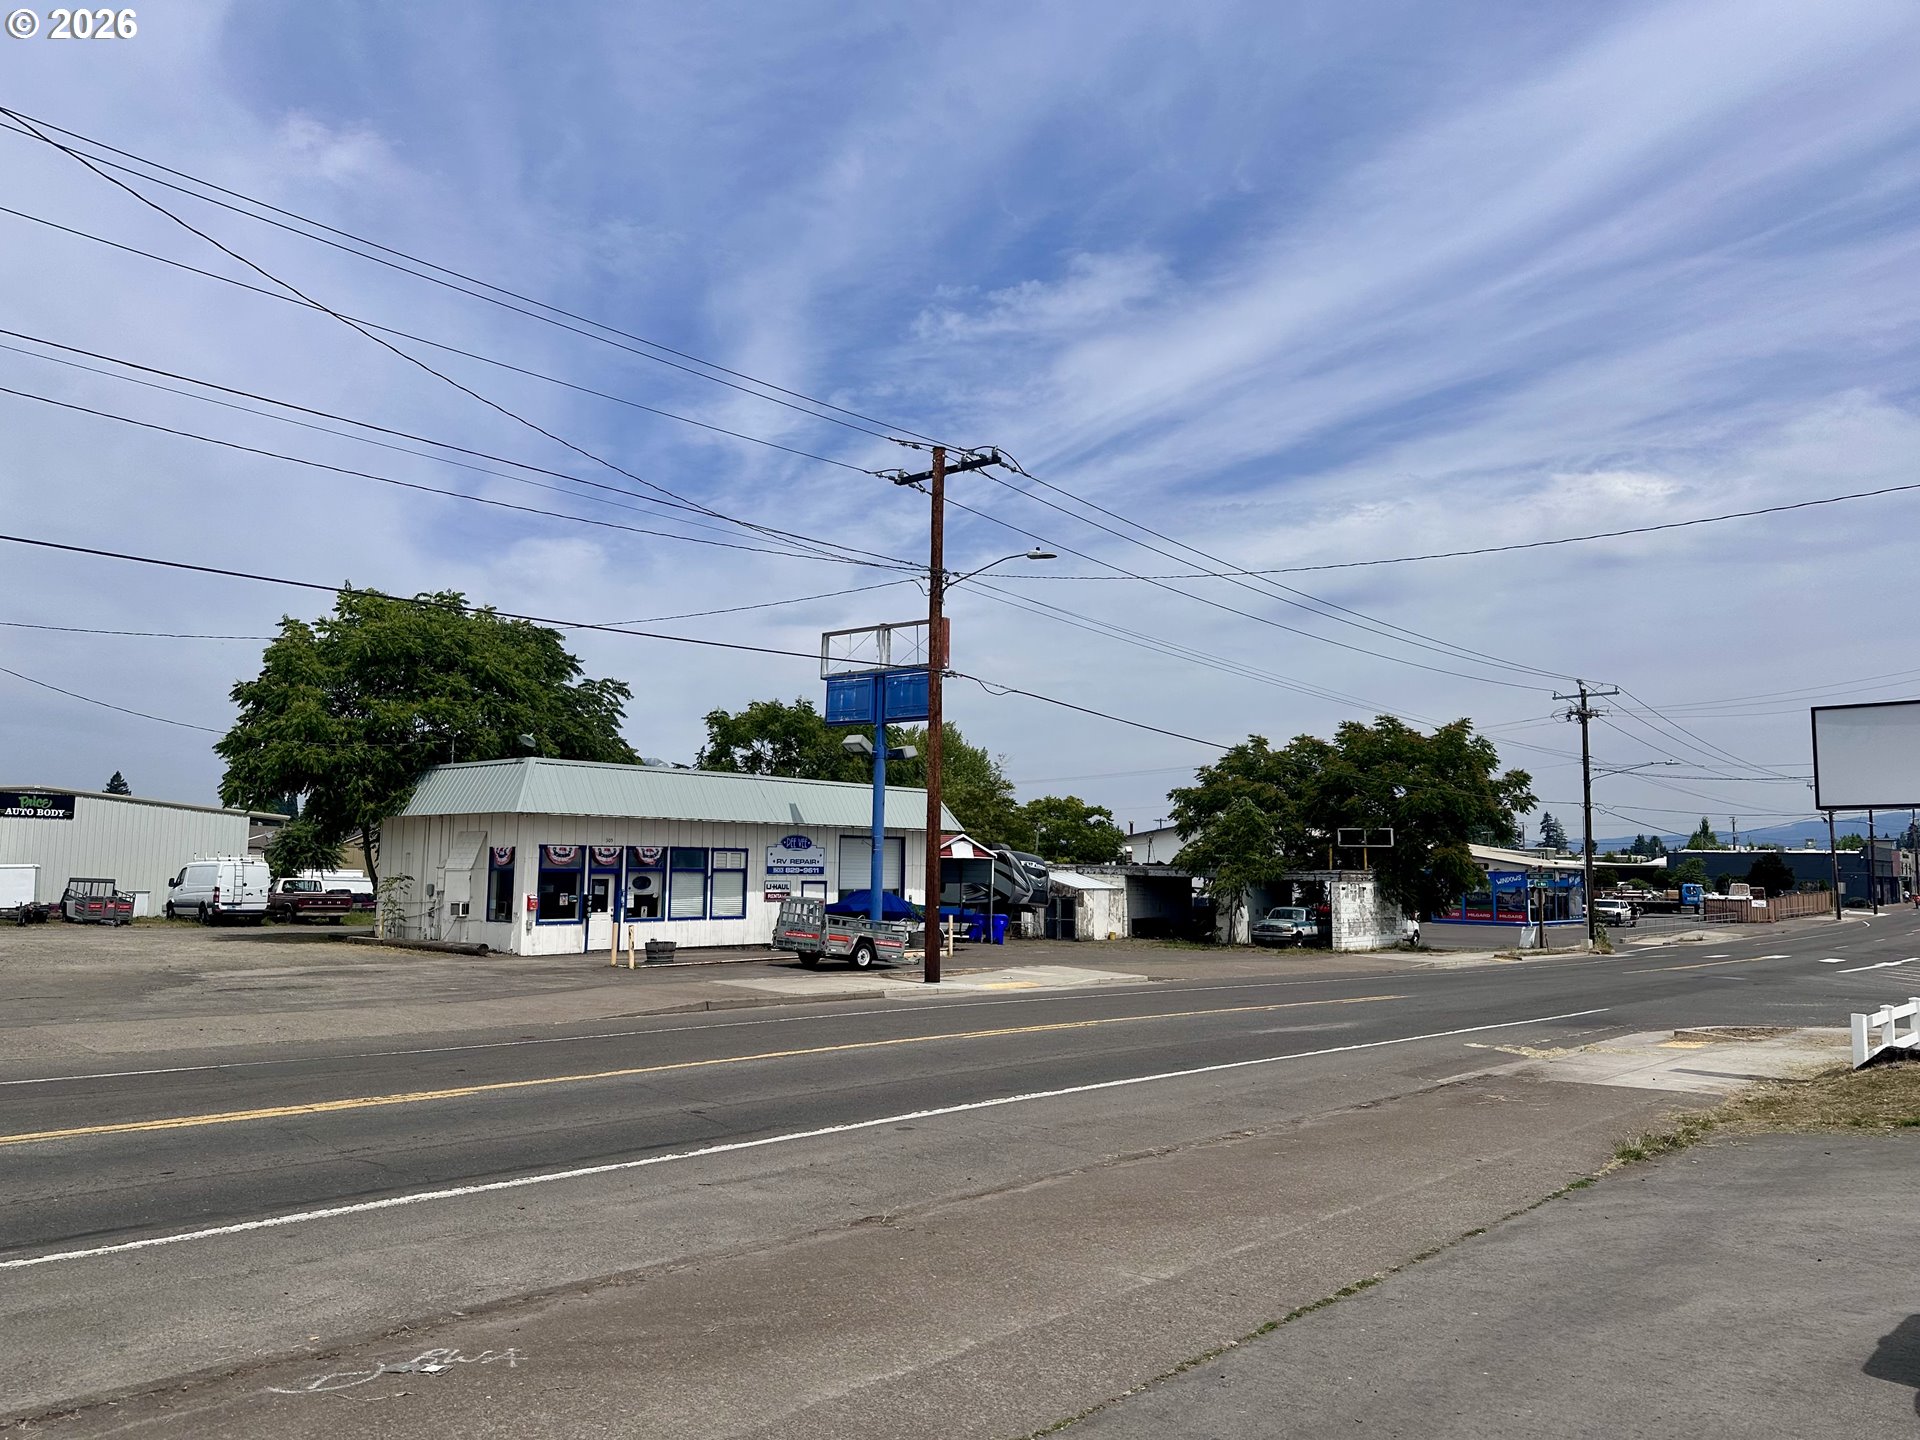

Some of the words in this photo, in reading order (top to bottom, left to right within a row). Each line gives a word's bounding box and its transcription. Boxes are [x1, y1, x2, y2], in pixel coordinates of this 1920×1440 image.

[18, 795, 53, 809] Price
[4, 807, 34, 816] AUTO
[36, 808, 65, 817] BODY
[1495, 874, 1522, 885] WINDOWS
